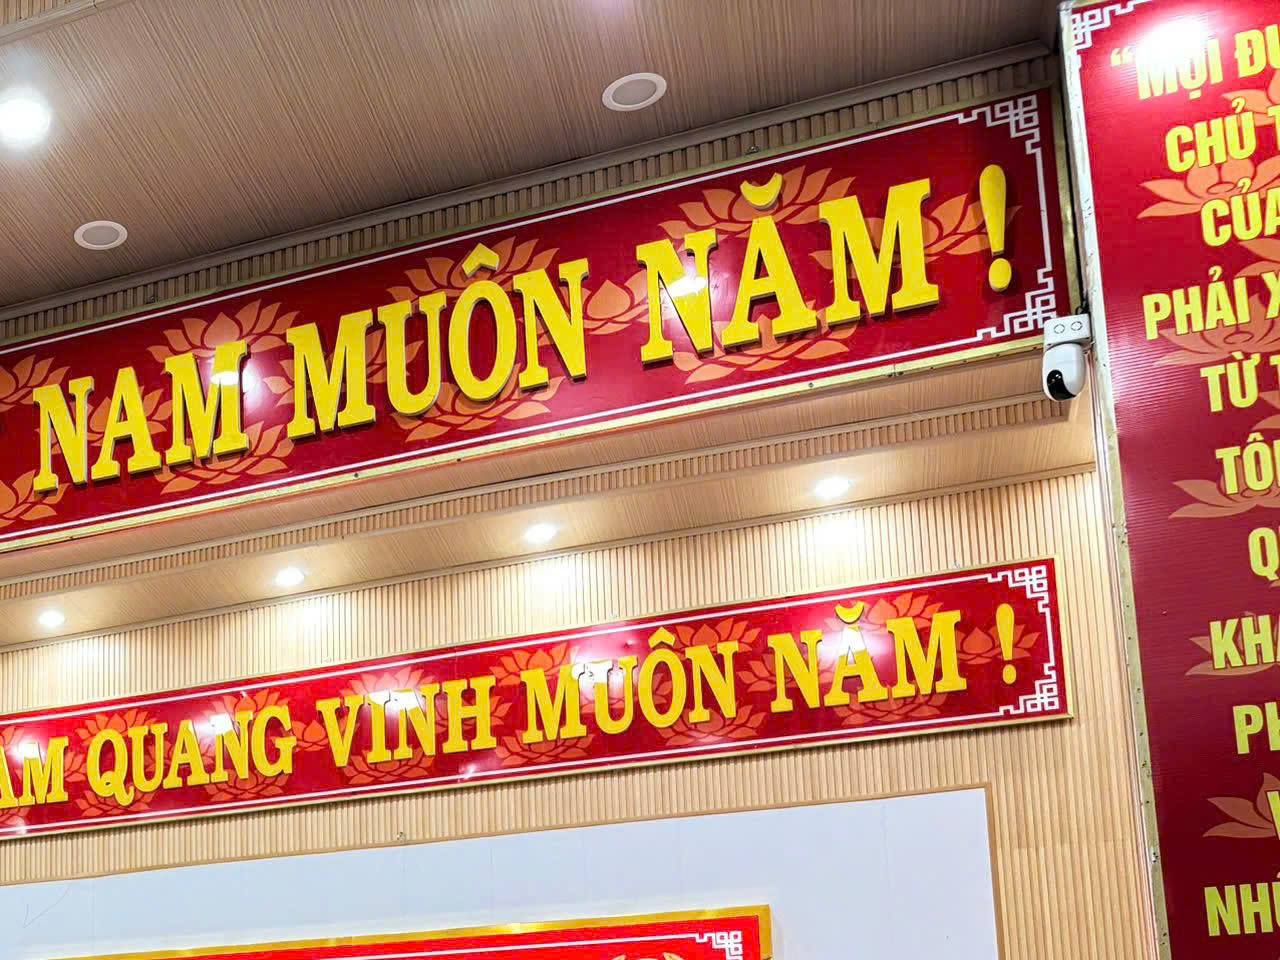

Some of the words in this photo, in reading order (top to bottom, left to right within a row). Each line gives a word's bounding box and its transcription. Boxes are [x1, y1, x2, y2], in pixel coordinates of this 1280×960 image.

[1165, 97, 1257, 173] CHỦ
[33, 339, 251, 492] NAM
[286, 242, 591, 441] MUÔN
[636, 171, 940, 370] NĂM
[1142, 265, 1251, 341] PHẢI
[1200, 350, 1261, 413] TỪ
[1215, 431, 1280, 495] TÔ
[1209, 613, 1280, 670] KH
[86, 704, 298, 807] QUANG
[316, 675, 498, 768] VINH
[520, 626, 740, 745] MUÔN
[767, 600, 969, 714] NĂM
[1204, 872, 1280, 937] NH
